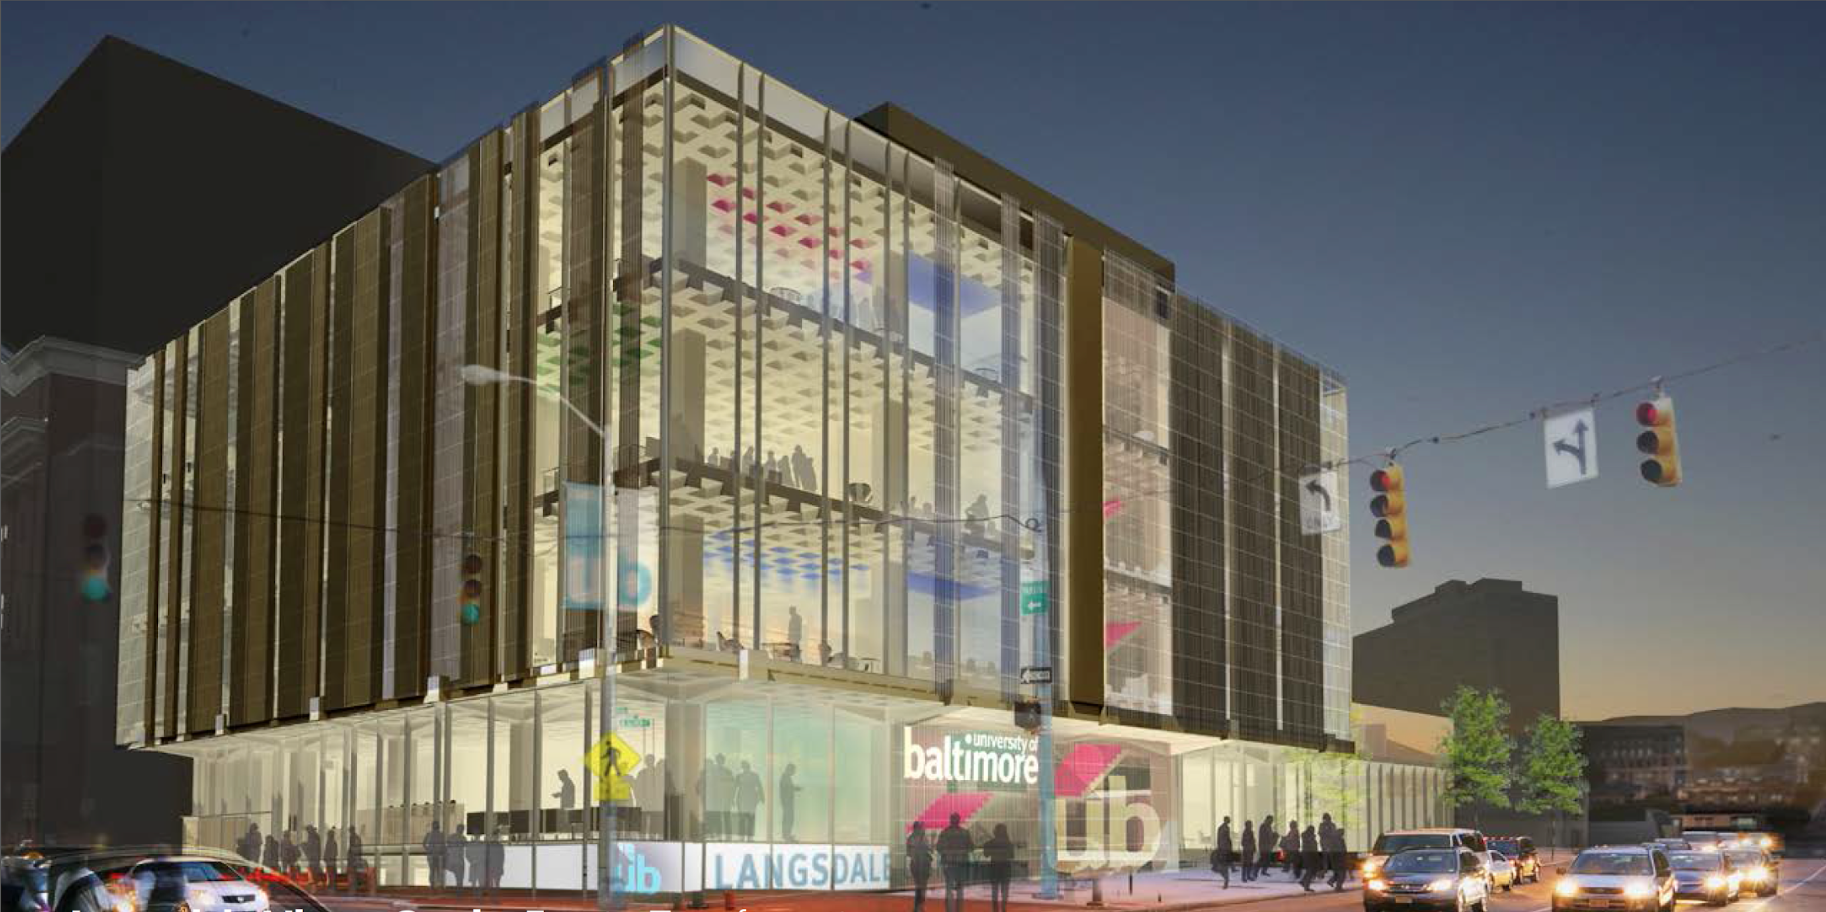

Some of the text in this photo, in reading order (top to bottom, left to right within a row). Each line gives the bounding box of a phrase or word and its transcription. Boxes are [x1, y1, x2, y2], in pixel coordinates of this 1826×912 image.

[904, 726, 1039, 784] baltimore
[973, 733, 1028, 754] university
[714, 852, 891, 890] LANGSDALE
